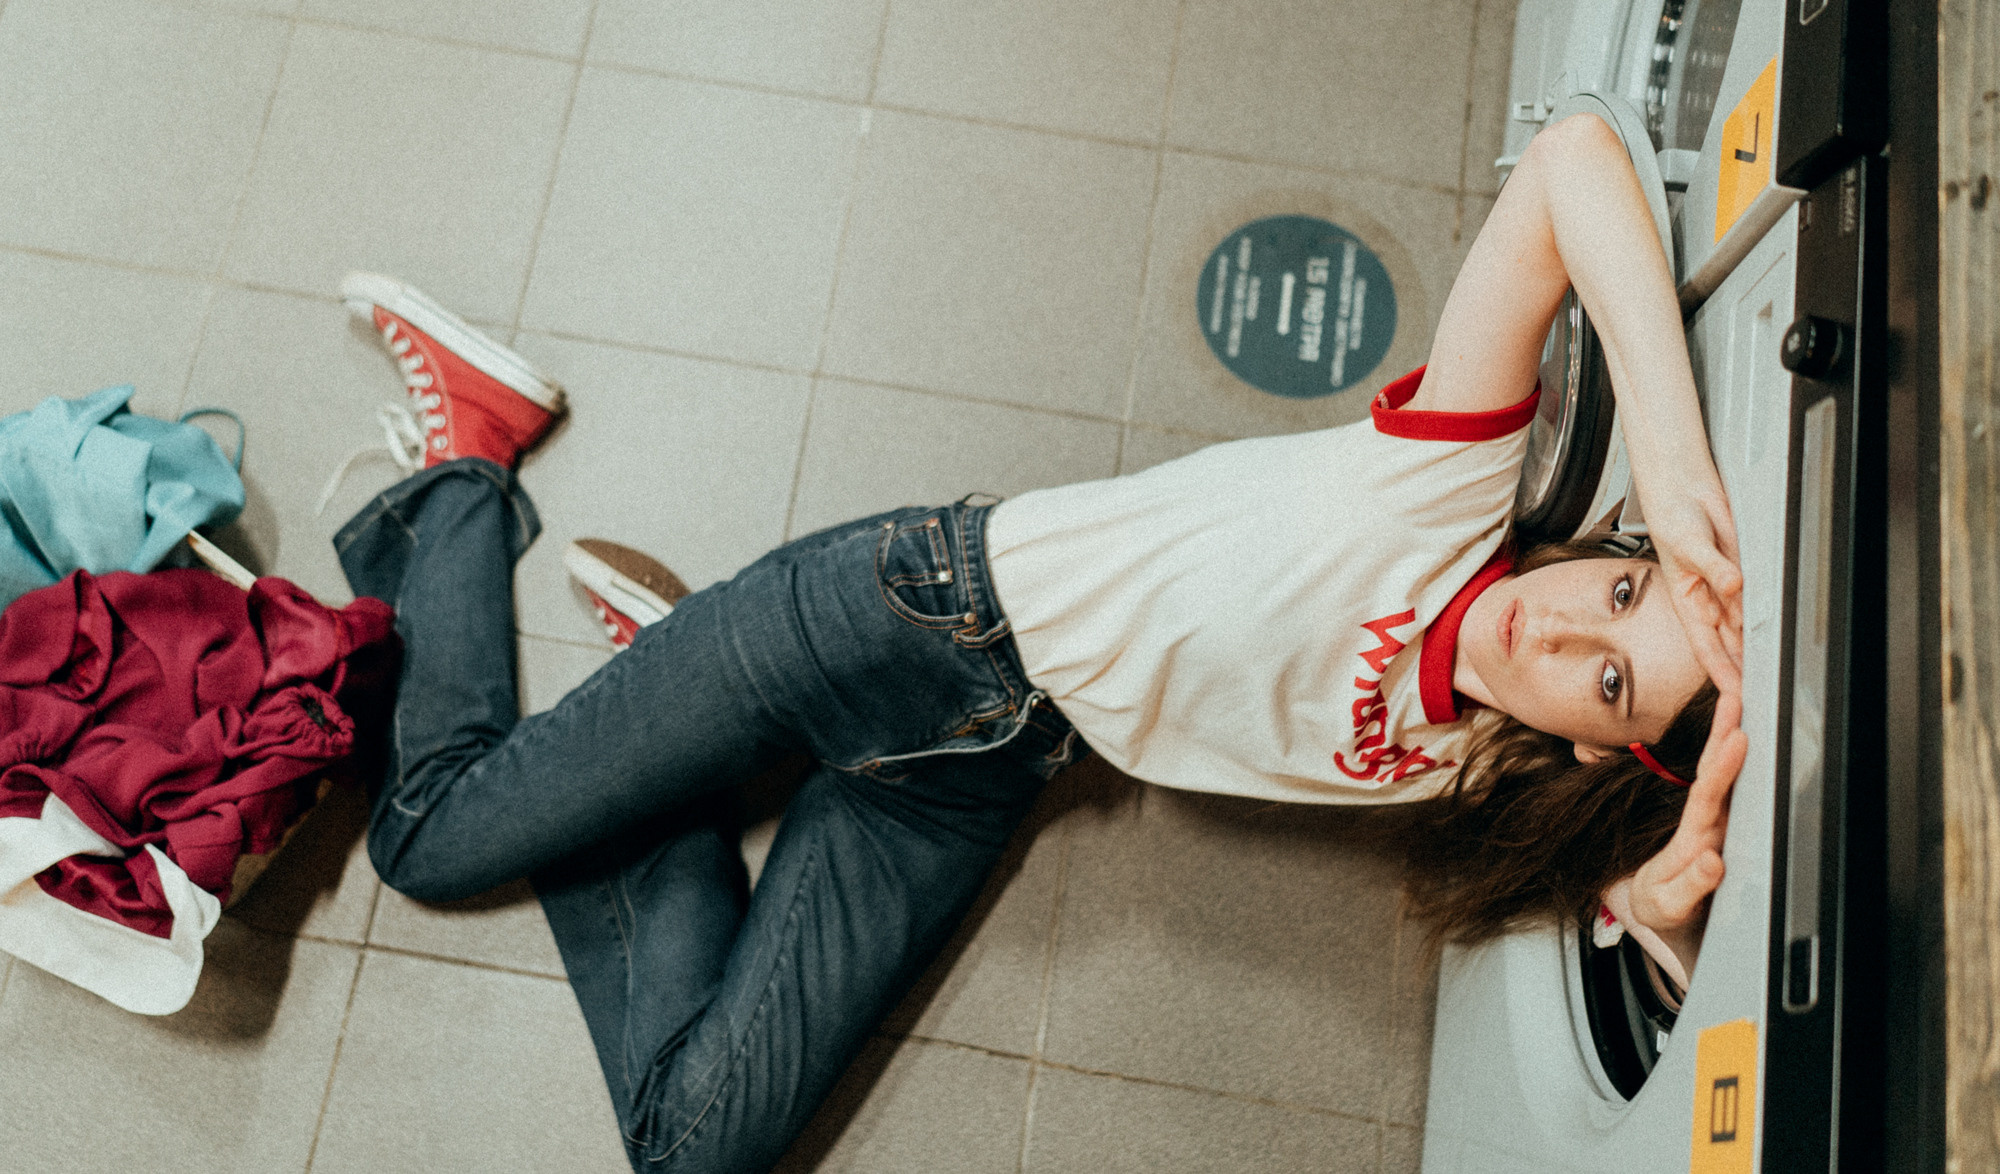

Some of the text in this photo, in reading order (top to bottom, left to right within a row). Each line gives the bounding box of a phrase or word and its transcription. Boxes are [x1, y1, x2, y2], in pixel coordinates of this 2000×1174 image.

[1735, 112, 1760, 163] 7
[1333, 607, 1458, 783] Wrangle
[1710, 1076, 1739, 1143] 8
